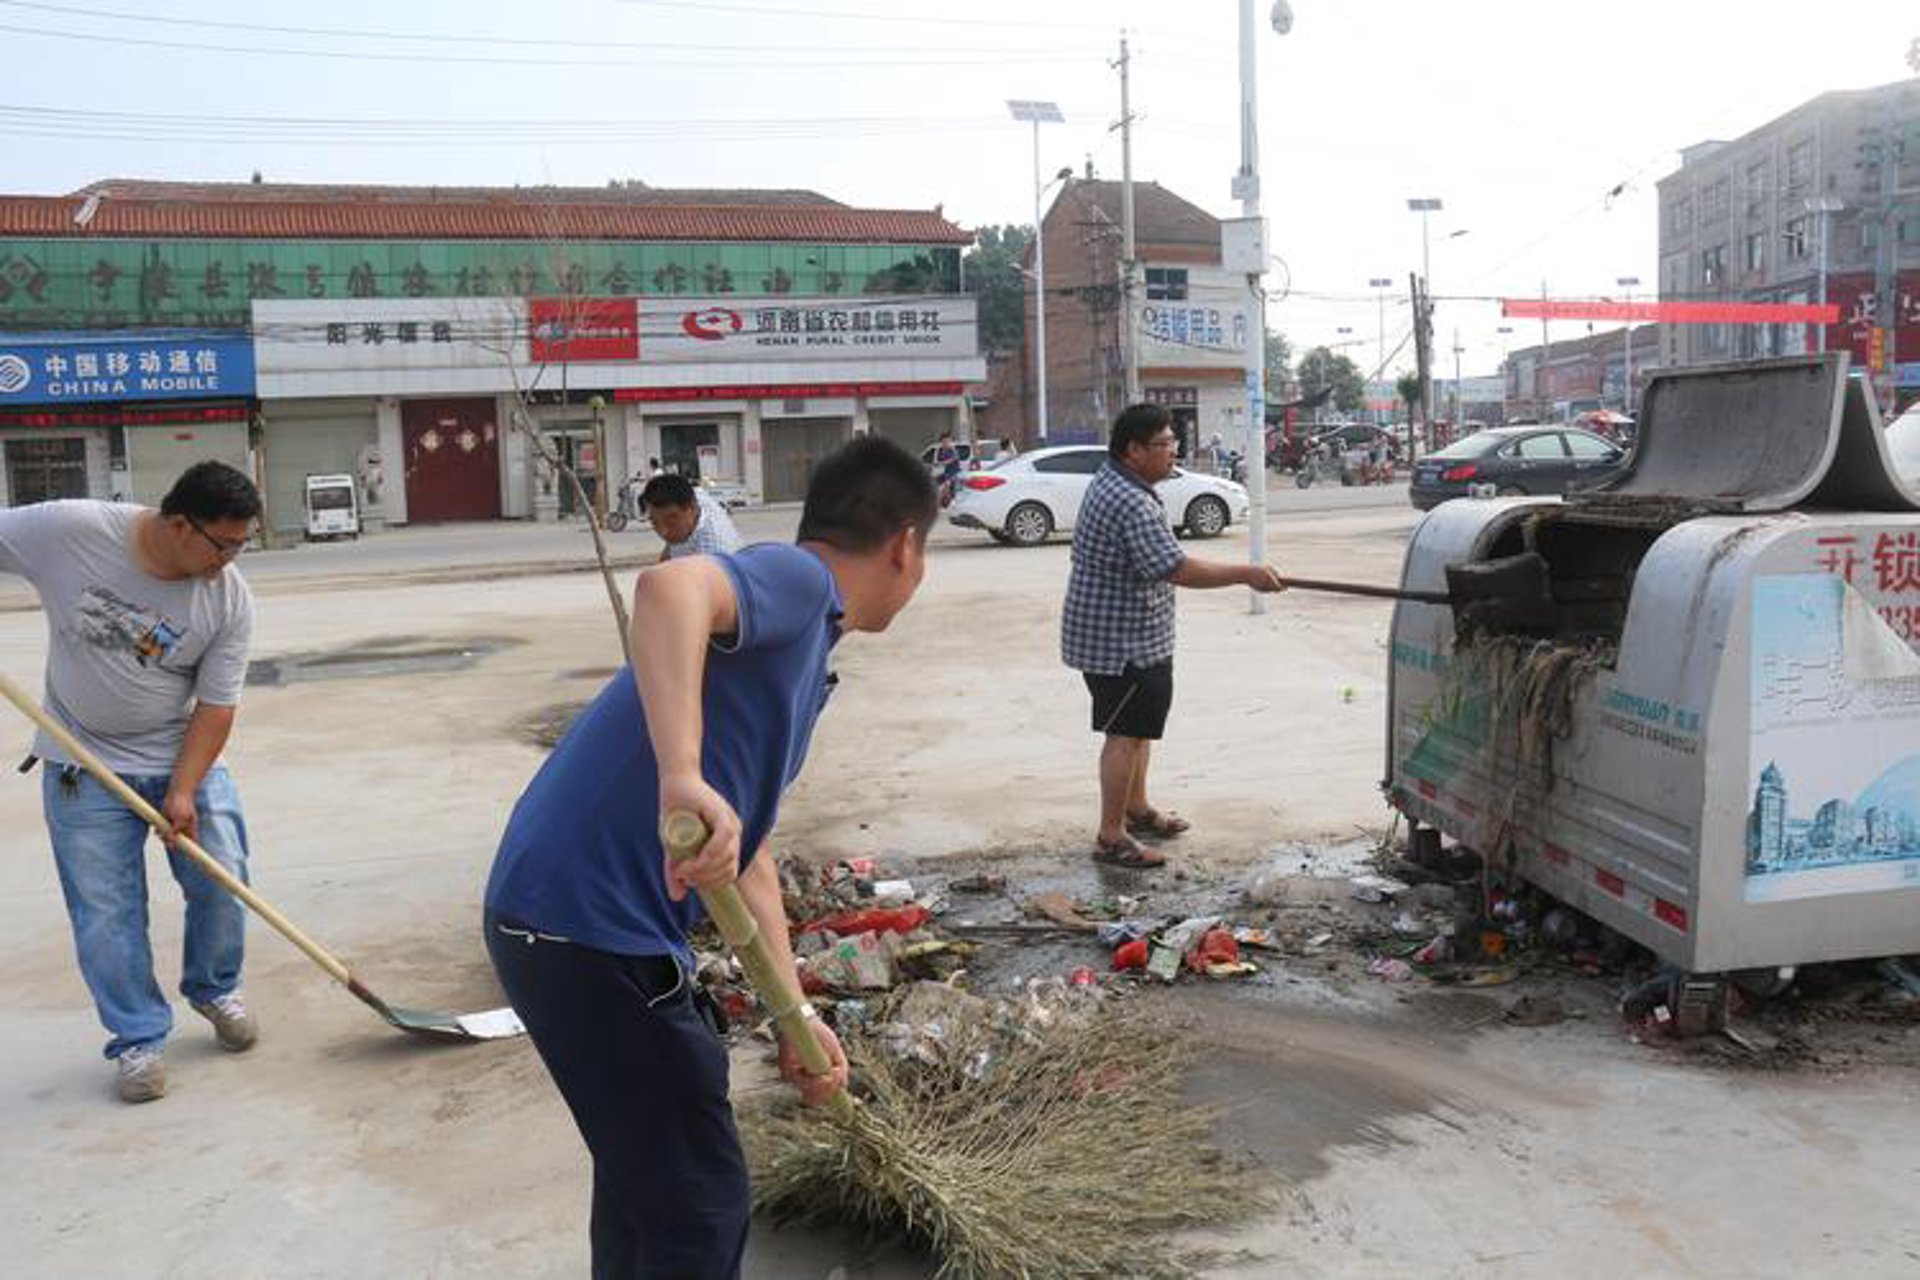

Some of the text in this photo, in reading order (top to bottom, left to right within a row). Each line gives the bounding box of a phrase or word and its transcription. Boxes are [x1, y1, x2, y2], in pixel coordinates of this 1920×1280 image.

[756, 307, 940, 334] 河南省农村信用社
[757, 332, 941, 346] HENAN RURAL CREDIT UNION
[45, 350, 218, 379] 中国移动通信
[48, 376, 219, 396] CHINA MOBILE
